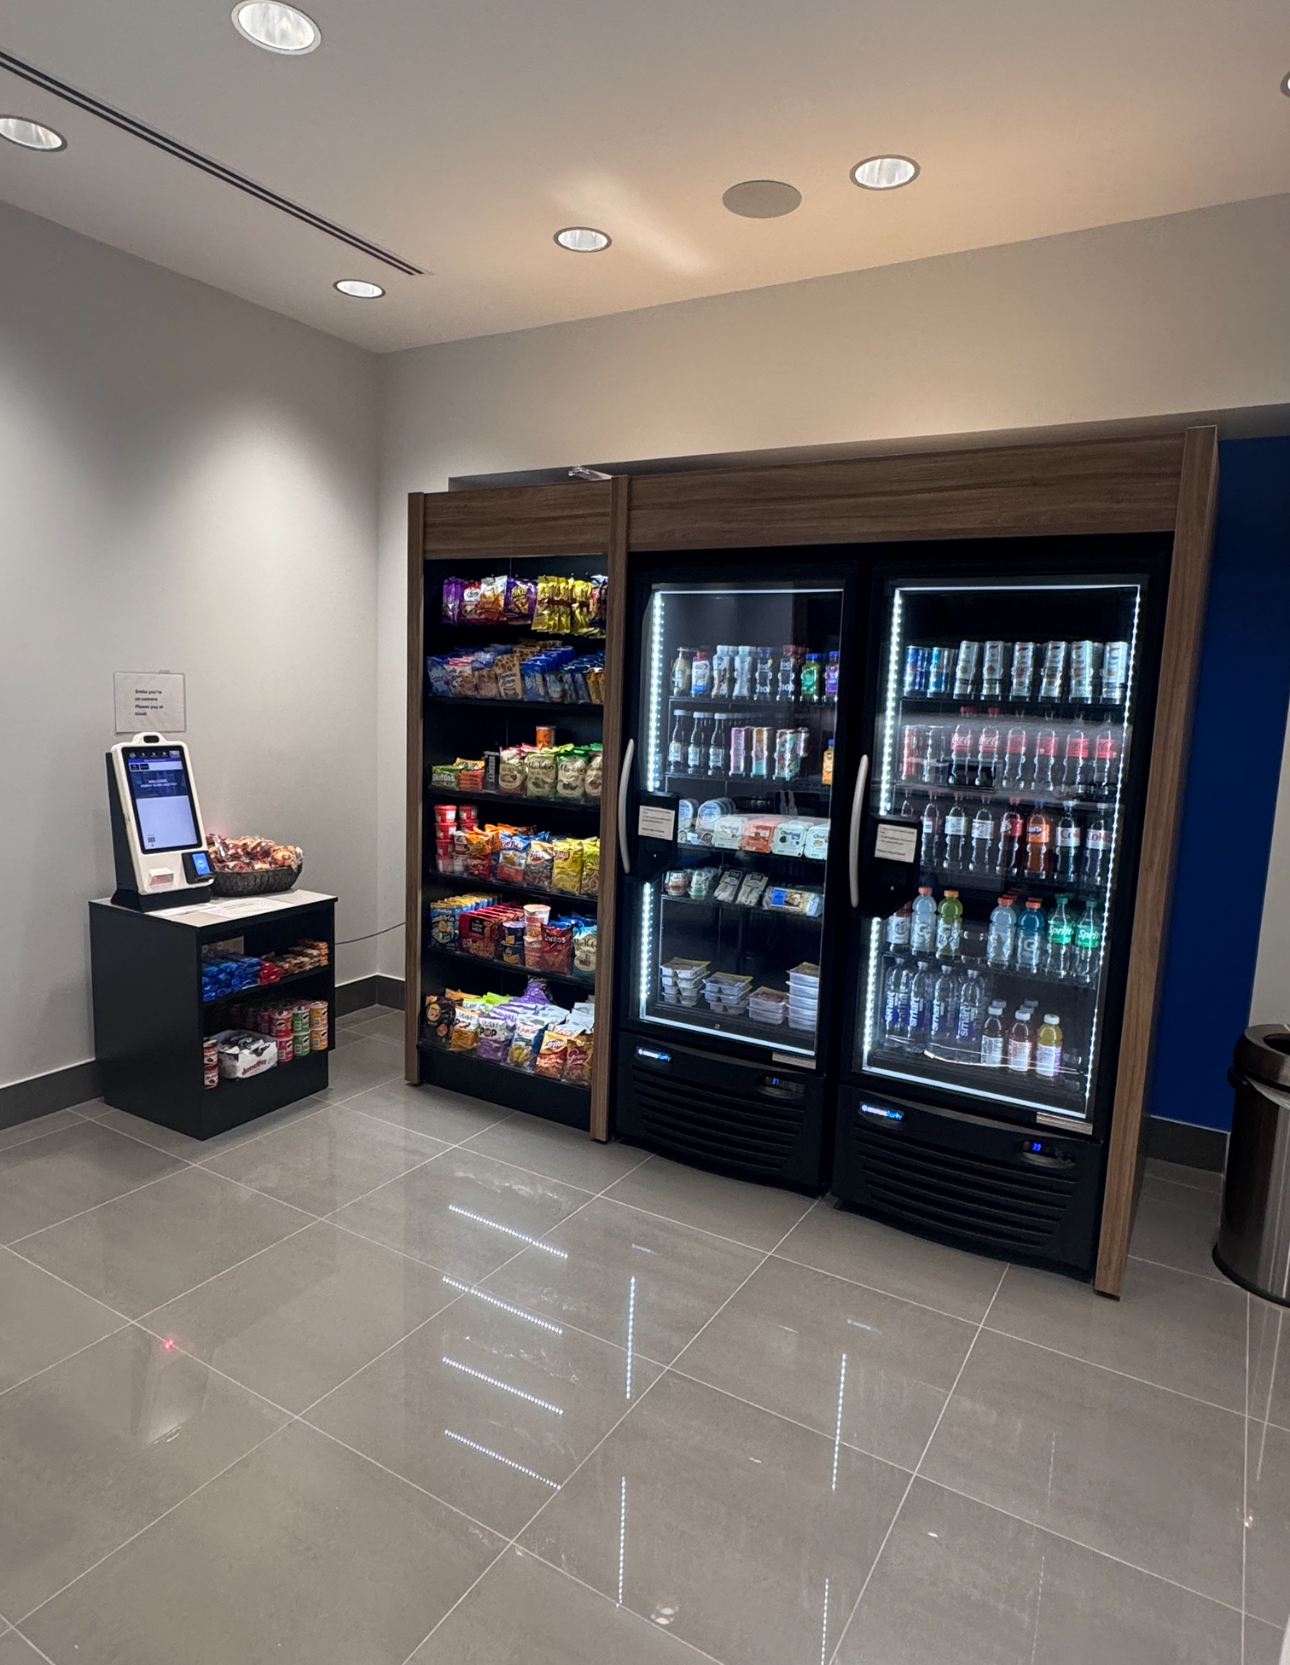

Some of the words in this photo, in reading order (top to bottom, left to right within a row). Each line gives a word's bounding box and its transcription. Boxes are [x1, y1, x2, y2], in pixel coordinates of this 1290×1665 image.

[1048, 925, 1073, 936] Sprite
[1078, 930, 1100, 940] Sprit
[910, 996, 920, 1028] smart
[961, 1002, 971, 1037] smart
[480, 1028, 497, 1038] POP
